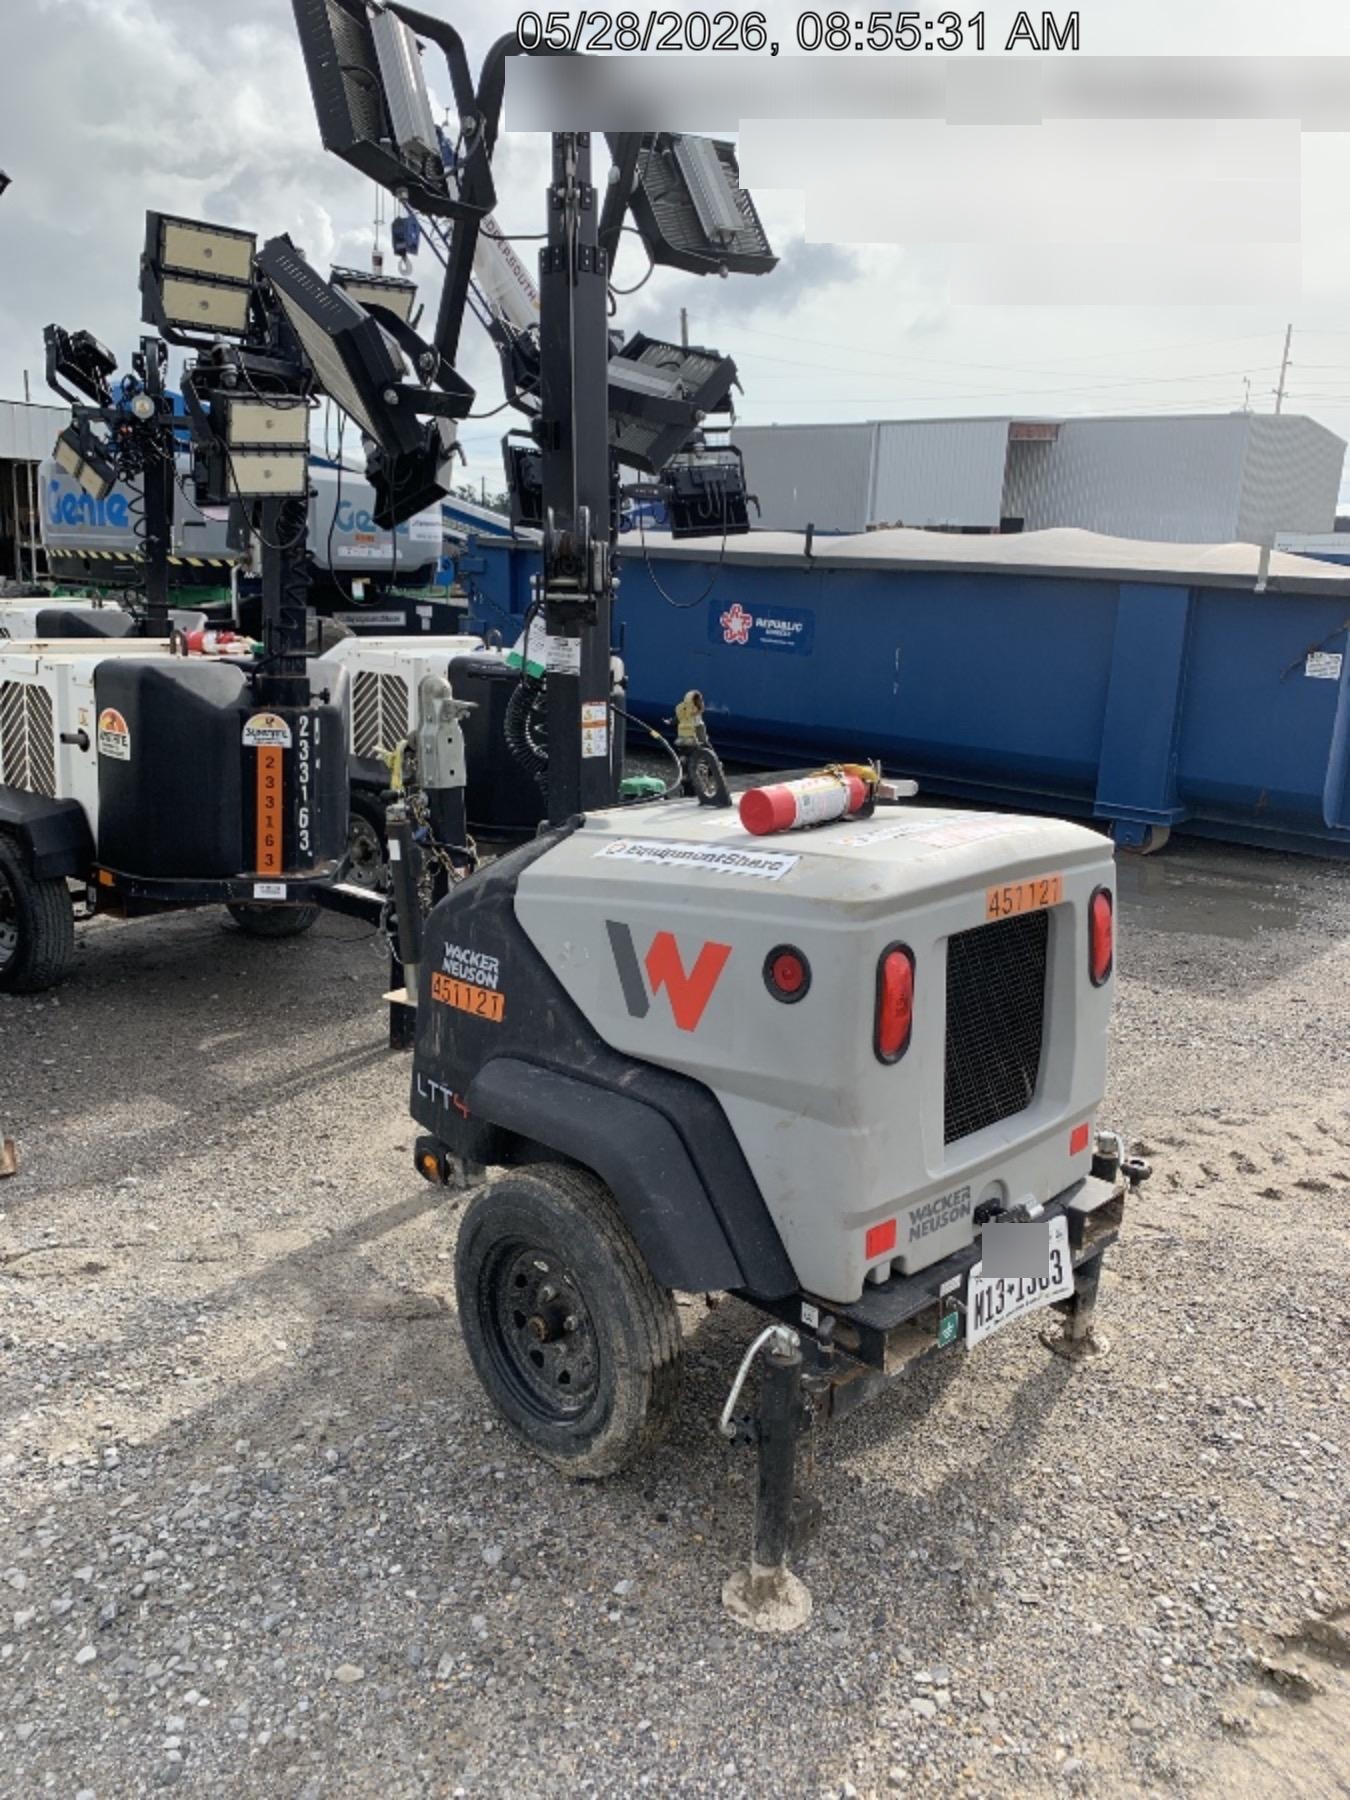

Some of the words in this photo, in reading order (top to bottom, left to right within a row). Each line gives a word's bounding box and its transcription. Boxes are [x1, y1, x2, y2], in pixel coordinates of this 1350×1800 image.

[625, 844, 784, 871] EquipmentShare
[441, 957, 499, 990] NEUSON
[444, 941, 499, 975] WACKER
[417, 1072, 471, 1119] LTT4
[908, 1185, 971, 1224] WACKER
[908, 1202, 972, 1243] NEUSON
